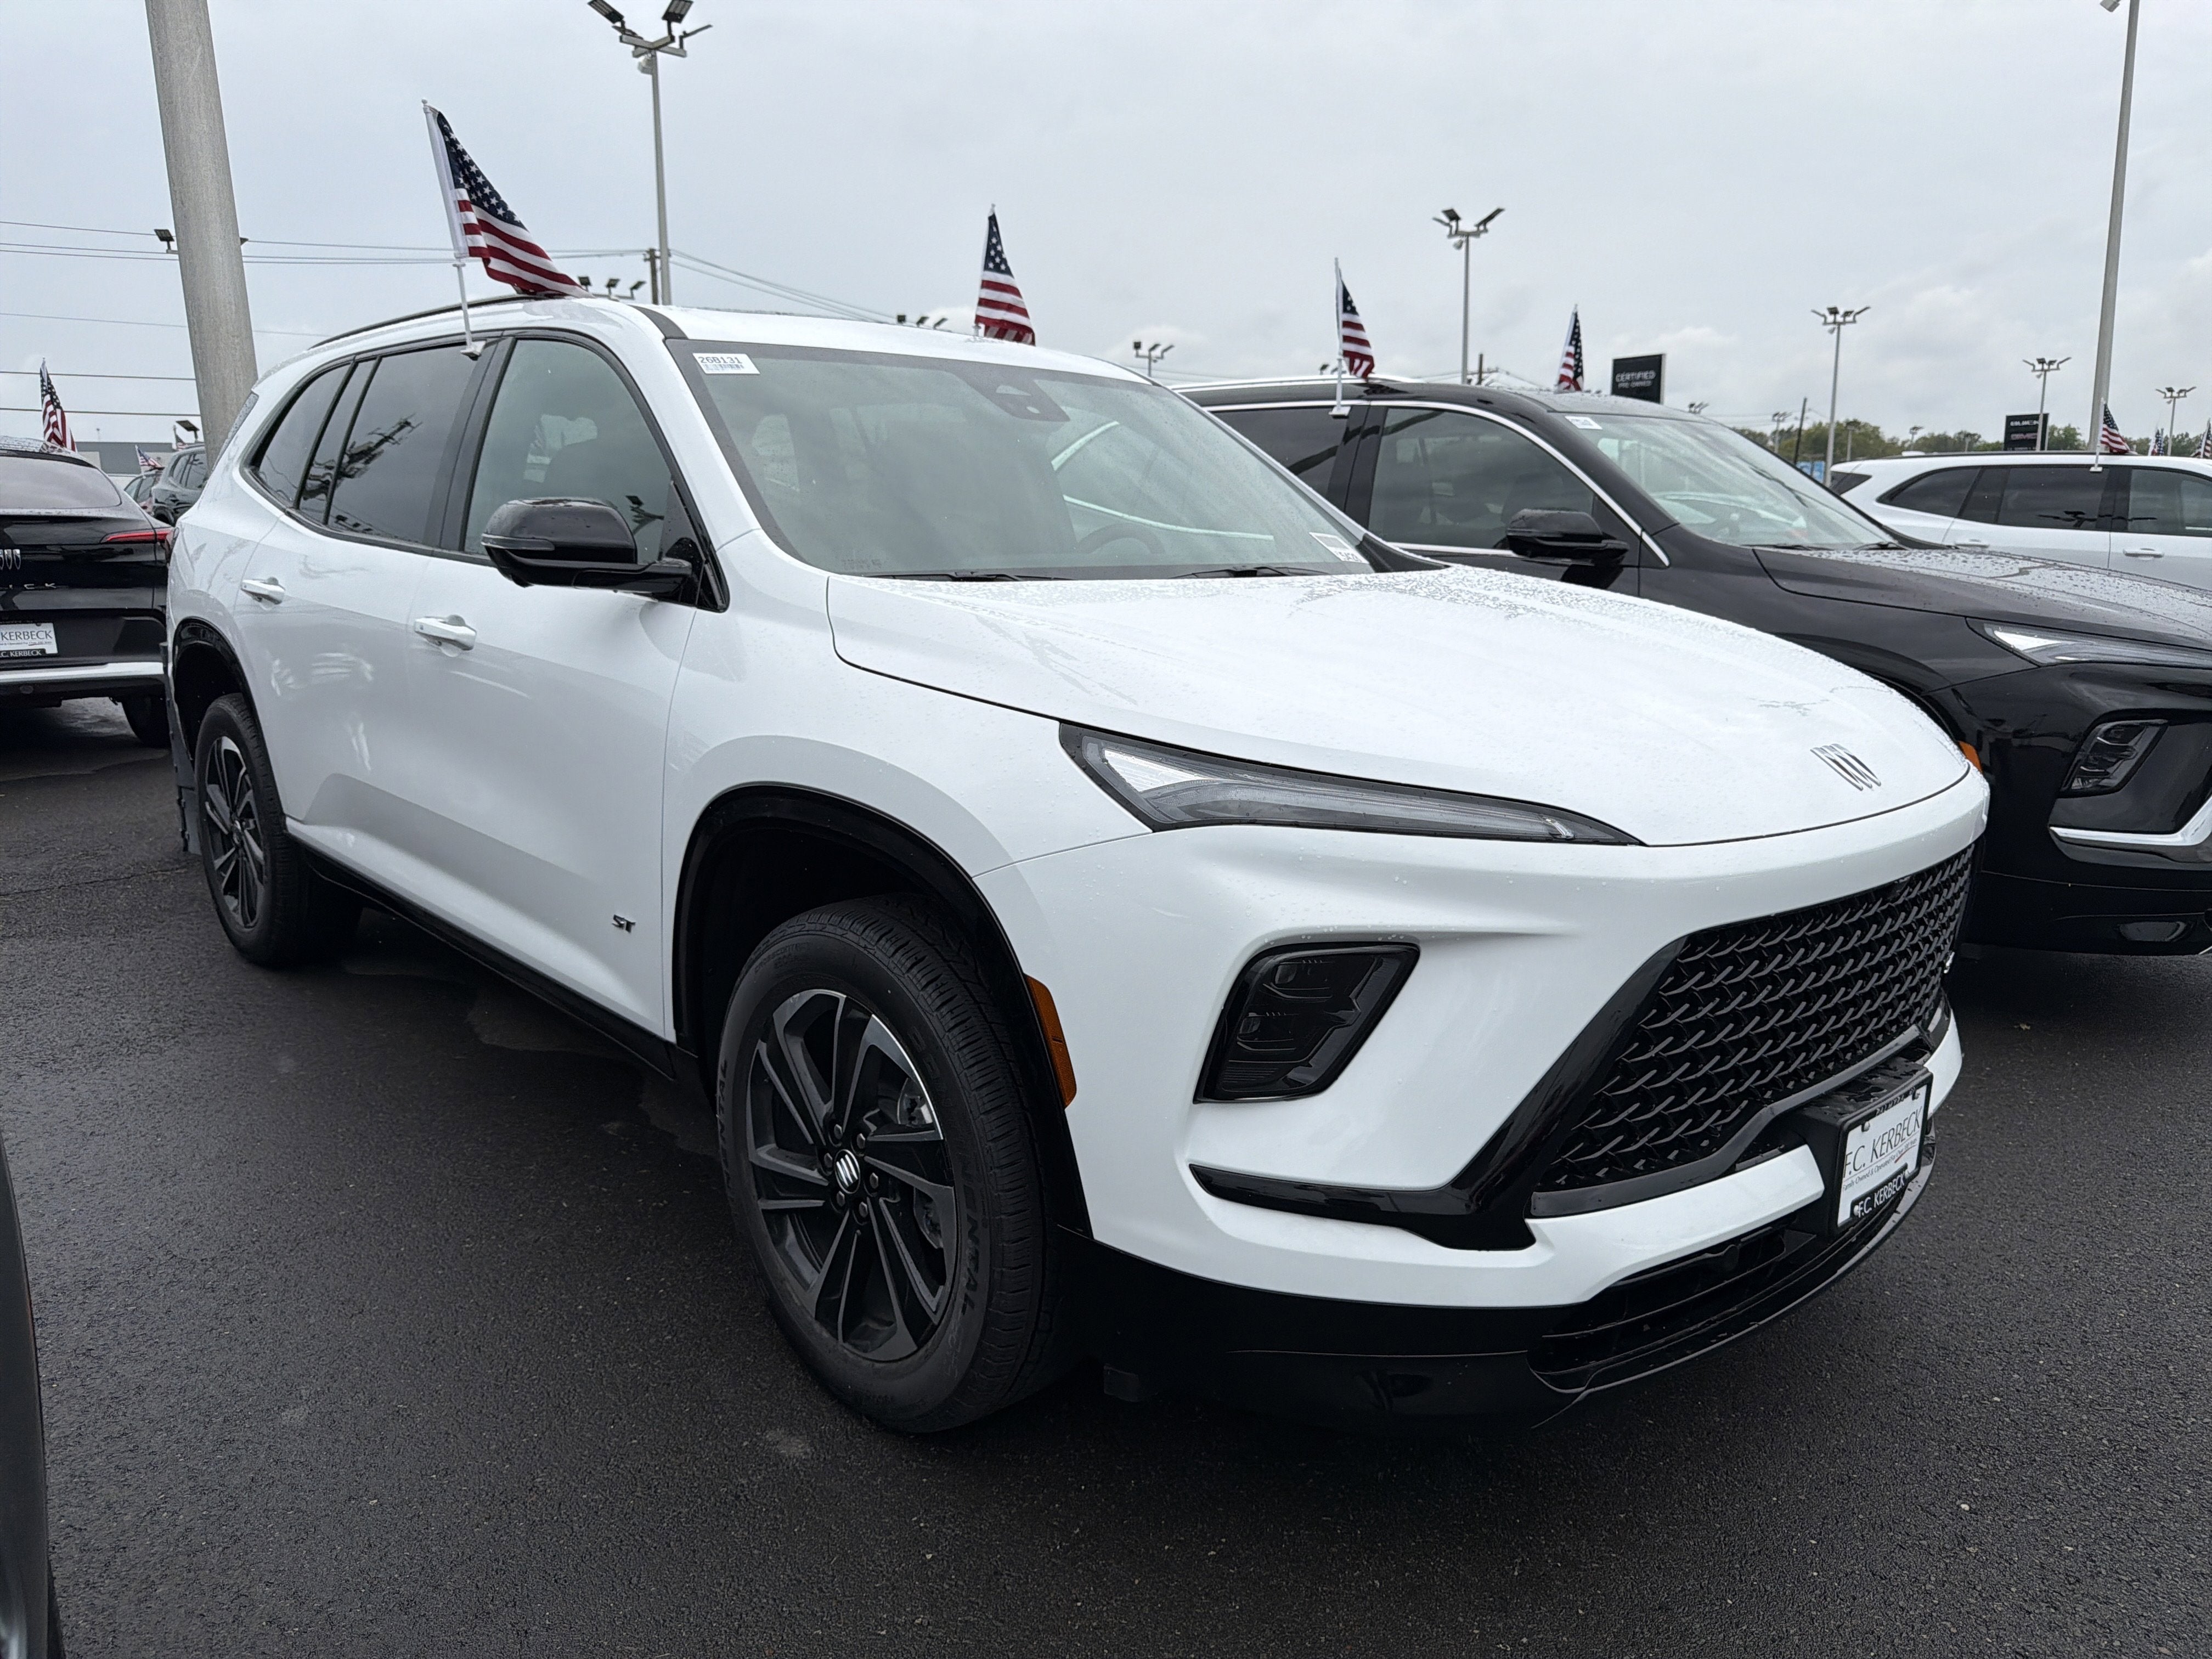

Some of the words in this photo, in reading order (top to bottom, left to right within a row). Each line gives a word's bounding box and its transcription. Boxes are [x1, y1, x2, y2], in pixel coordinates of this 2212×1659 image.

[1616, 370, 1656, 382] CERTIFIED
[1, 630, 53, 641] KERBECK
[612, 914, 636, 933] ST
[1843, 1144, 1866, 1178] F.C.
[1870, 1106, 1922, 1163] KERBECK
[1857, 1196, 1872, 1218] F.C.
[1874, 1172, 1906, 1208] KERBECK
